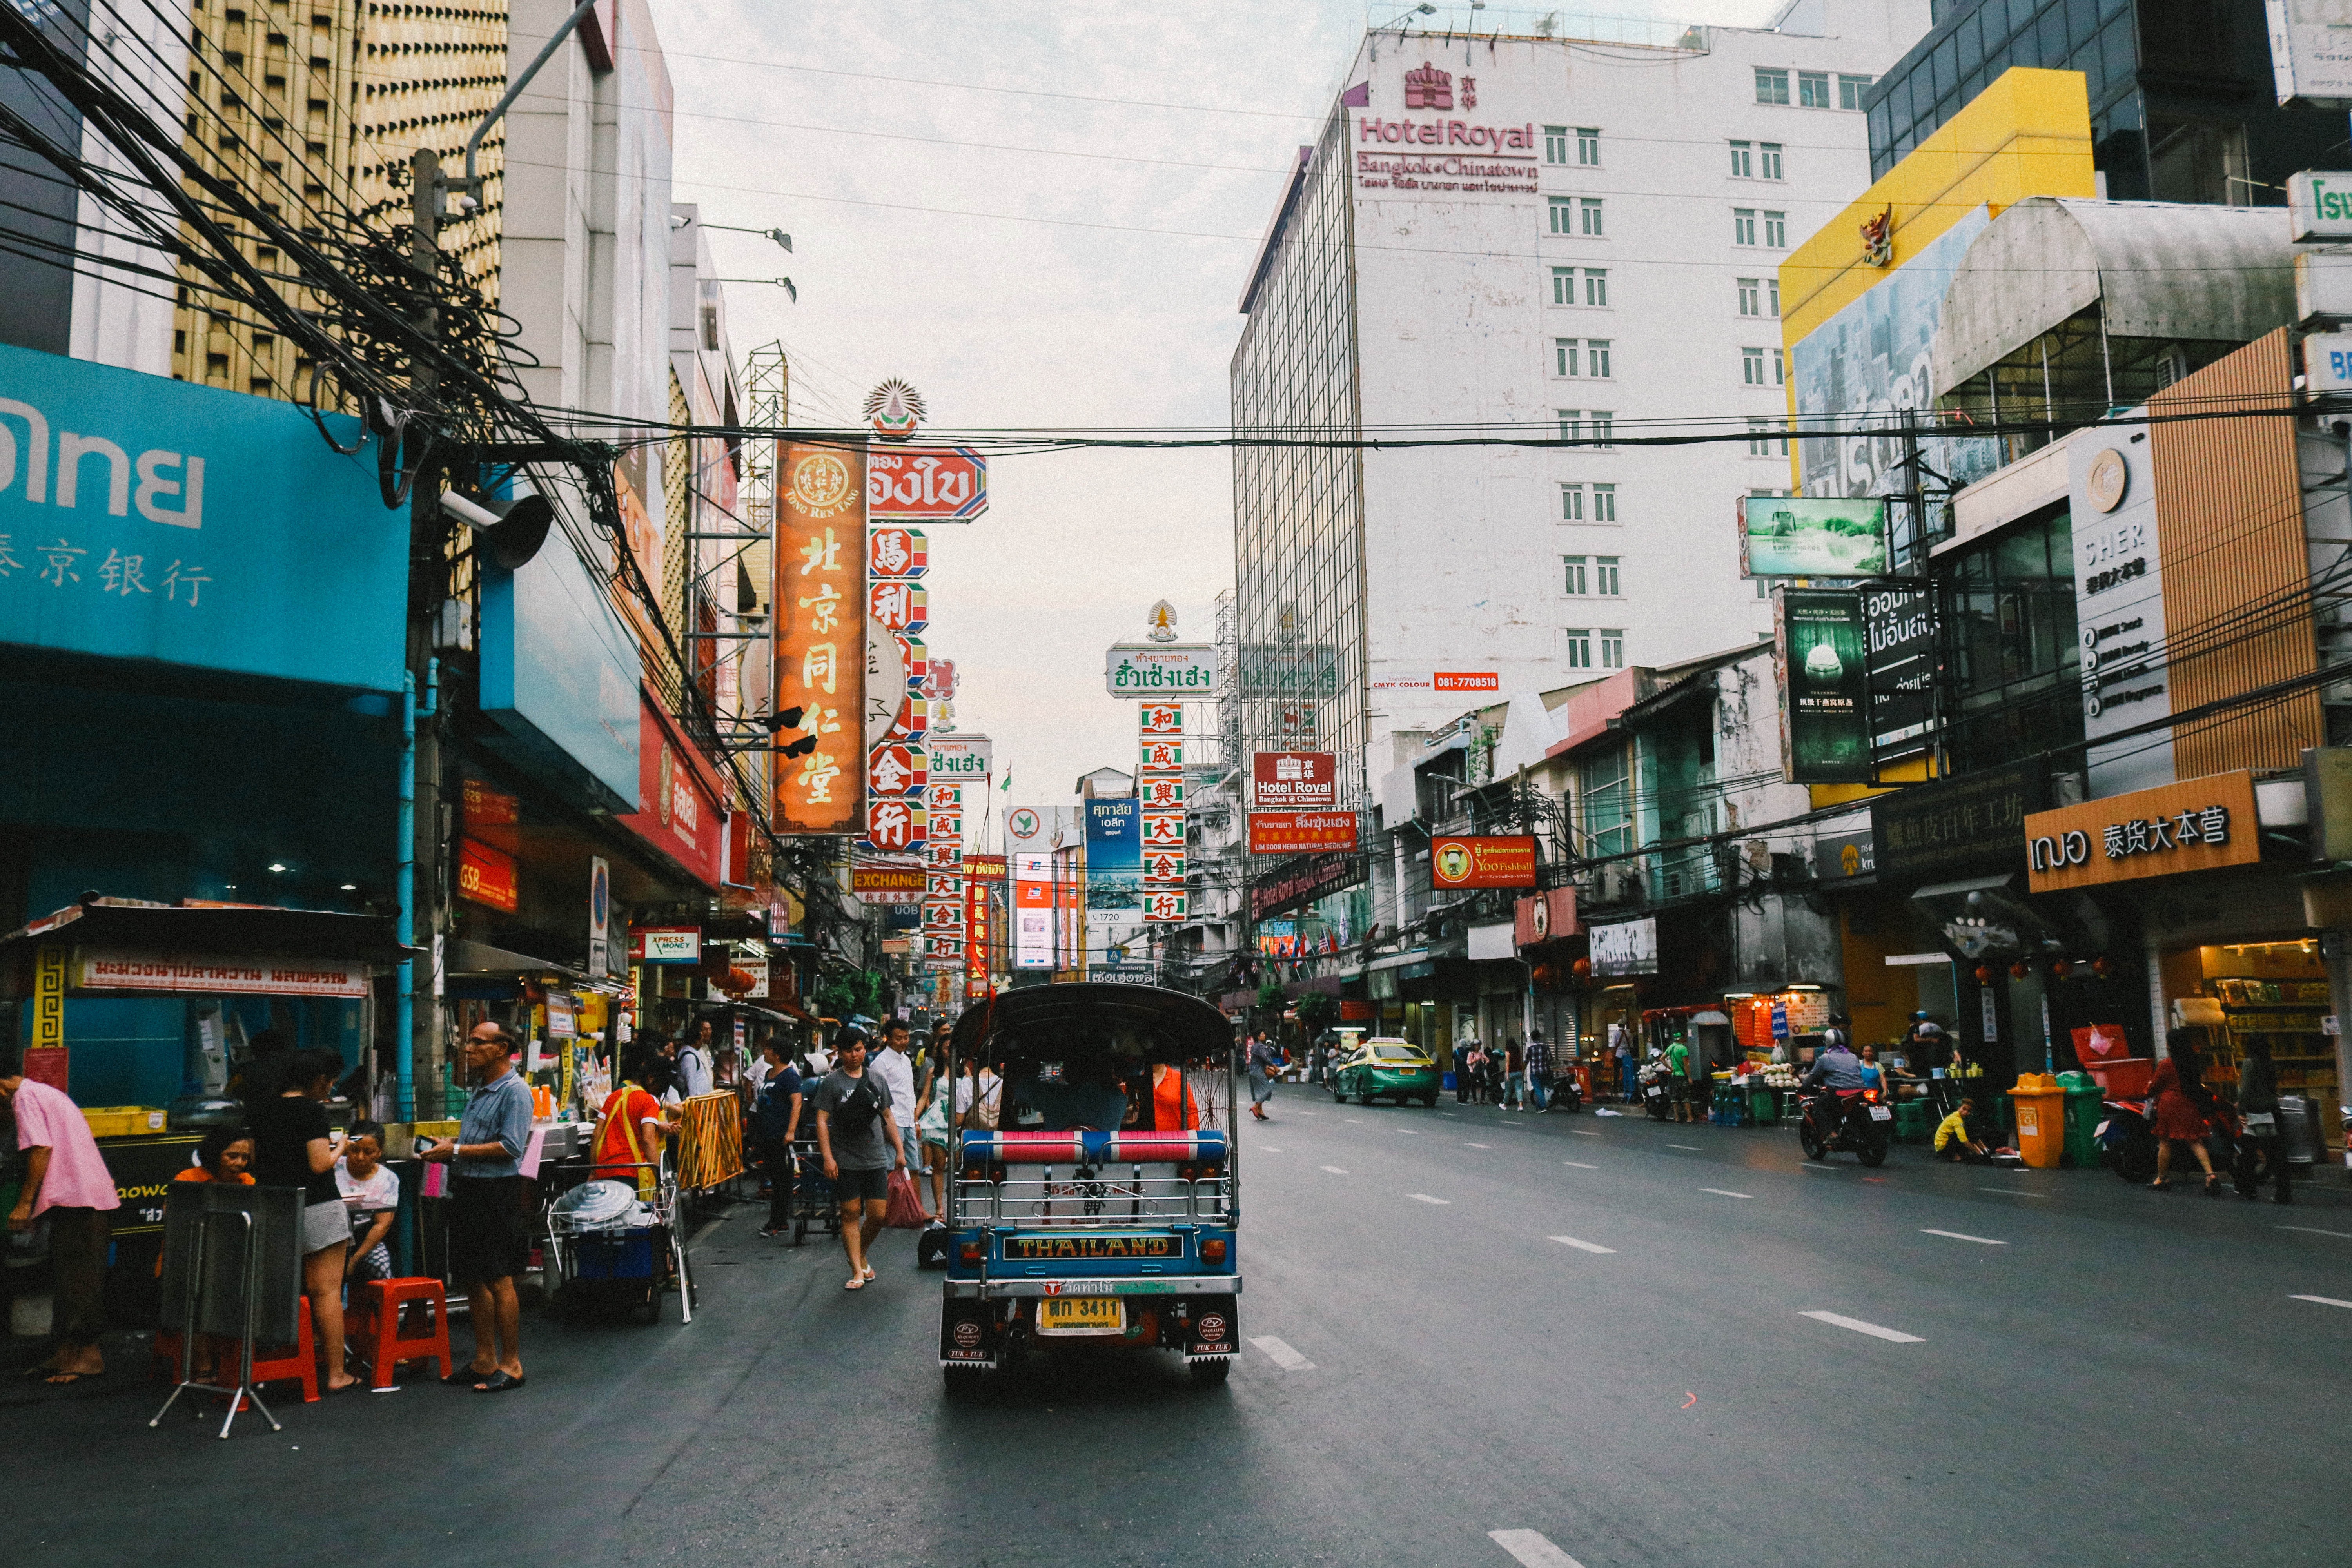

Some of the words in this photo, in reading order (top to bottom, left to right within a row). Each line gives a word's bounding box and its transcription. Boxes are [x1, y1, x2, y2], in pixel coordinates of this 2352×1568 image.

[1361, 117, 1443, 142] Hotel
[1448, 120, 1534, 153] Royal
[1358, 155, 1432, 178] Bangkok
[1443, 157, 1538, 178] Chinatown
[785, 489, 808, 514] TONG
[810, 506, 835, 518] REN
[835, 489, 859, 512] TANG
[2086, 524, 2145, 566] SHER
[798, 527, 843, 804] 北京同仁堂
[1136, 652, 1189, 663] ห้างขายทอง
[1115, 659, 1210, 687] ฮั่วเซ่งเฮง
[1437, 677, 1497, 687] 081-7708518
[1303, 760, 1314, 780] 京华
[1258, 781, 1292, 793] Hotel
[1295, 781, 1331, 794] Royal
[1152, 709, 1176, 918] 和成興大金行
[2103, 806, 2226, 858] 泰货大本营
[934, 788, 953, 956] 和成興大金行
[1500, 862, 1532, 871] Fishball
[854, 873, 926, 887] EXCHANGE
[895, 906, 918, 915] UOB
[1018, 1236, 1169, 1258] THAILAND
[1080, 1300, 1116, 1316] 3411
